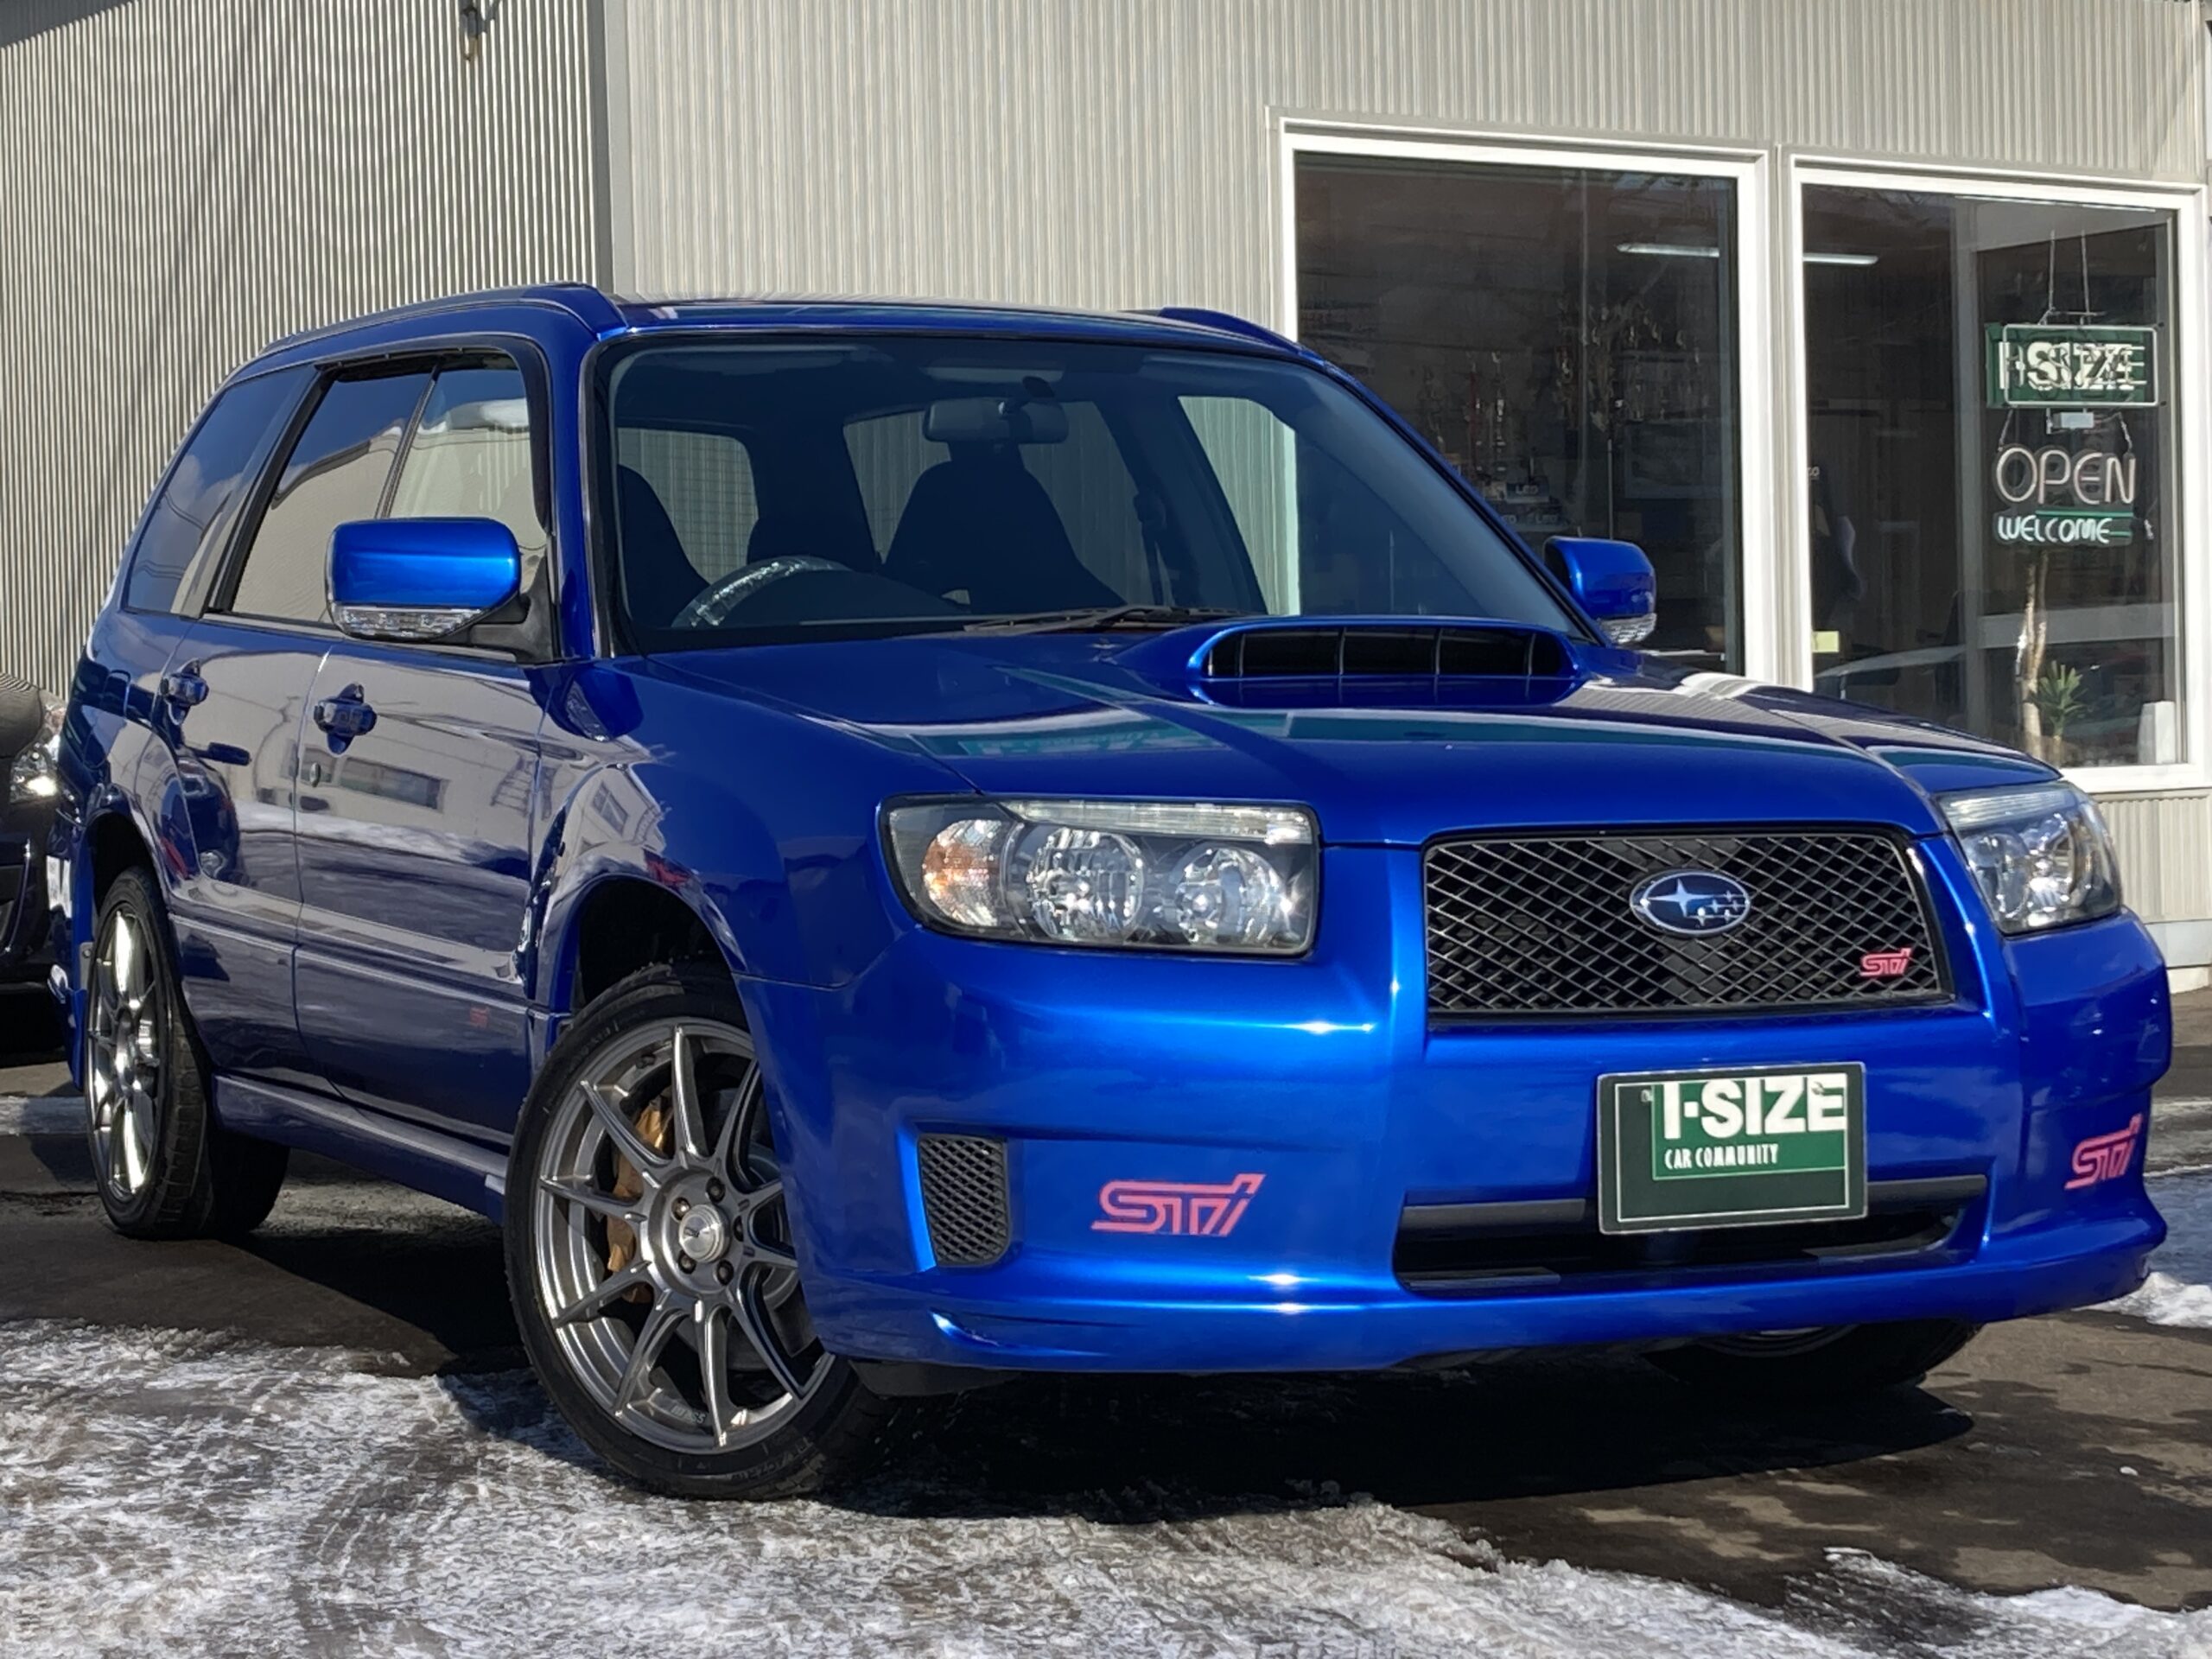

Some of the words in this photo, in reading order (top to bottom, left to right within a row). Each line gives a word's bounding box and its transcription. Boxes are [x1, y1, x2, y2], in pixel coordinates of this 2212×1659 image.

[1996, 447, 2136, 505] OPEN
[1997, 515, 2113, 544] WELCOME
[1664, 1147, 1692, 1170] CAR
[1695, 1142, 1779, 1167] COMMUNITY
